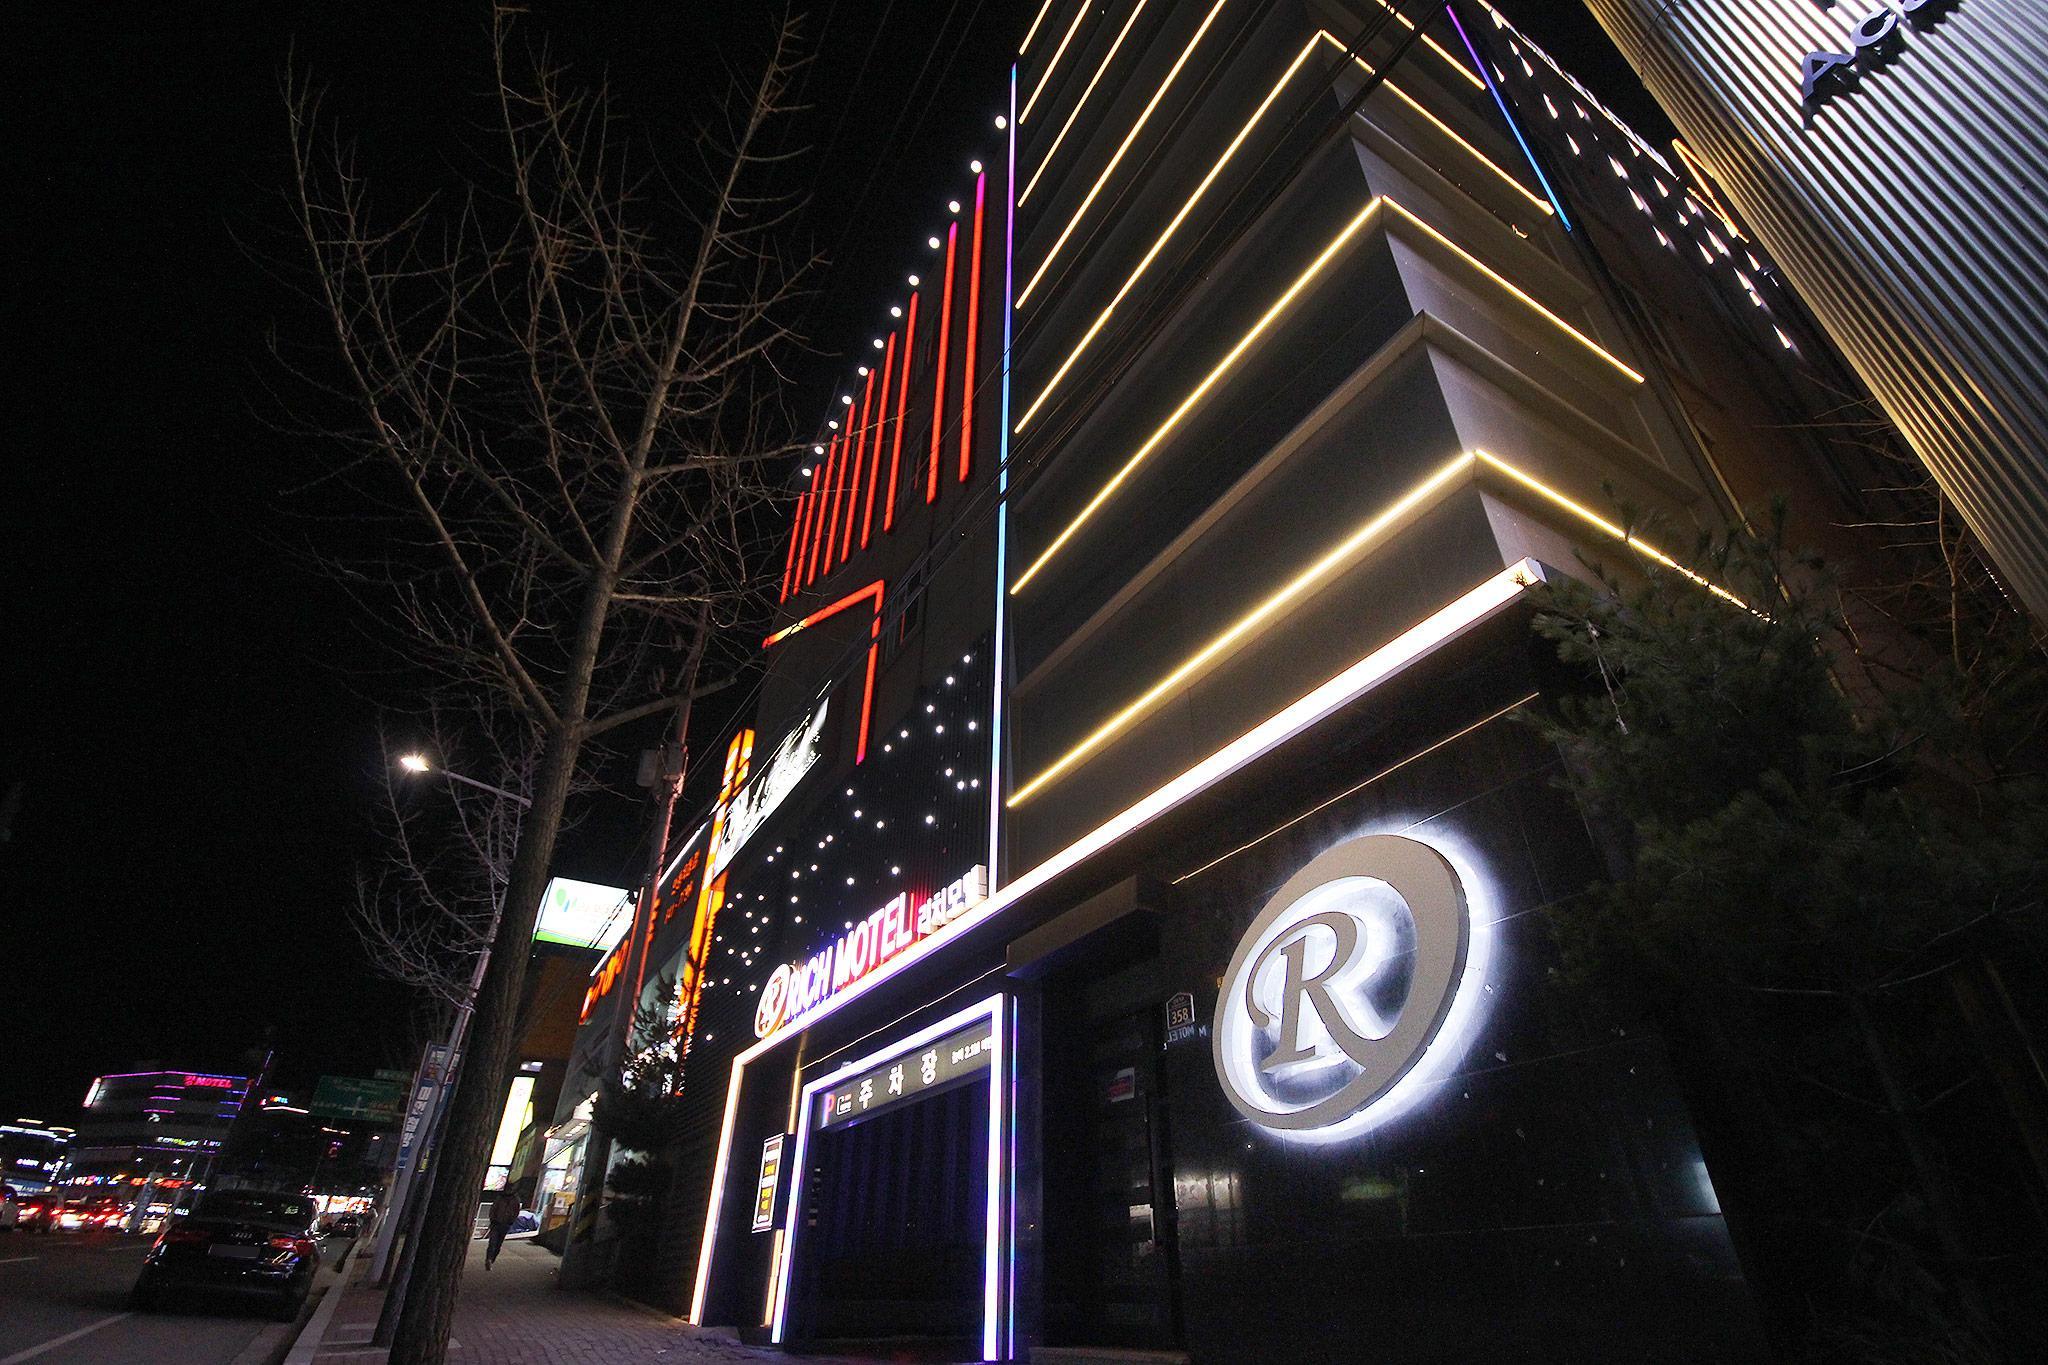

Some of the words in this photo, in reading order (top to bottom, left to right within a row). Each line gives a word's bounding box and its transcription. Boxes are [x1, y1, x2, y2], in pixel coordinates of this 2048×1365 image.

[785, 944, 833, 1019] RICH
[835, 891, 913, 988] MOTEL
[1171, 1007, 1189, 1025] 358
[196, 1076, 233, 1089] MOTEL
[858, 1047, 938, 1110] 주차장
